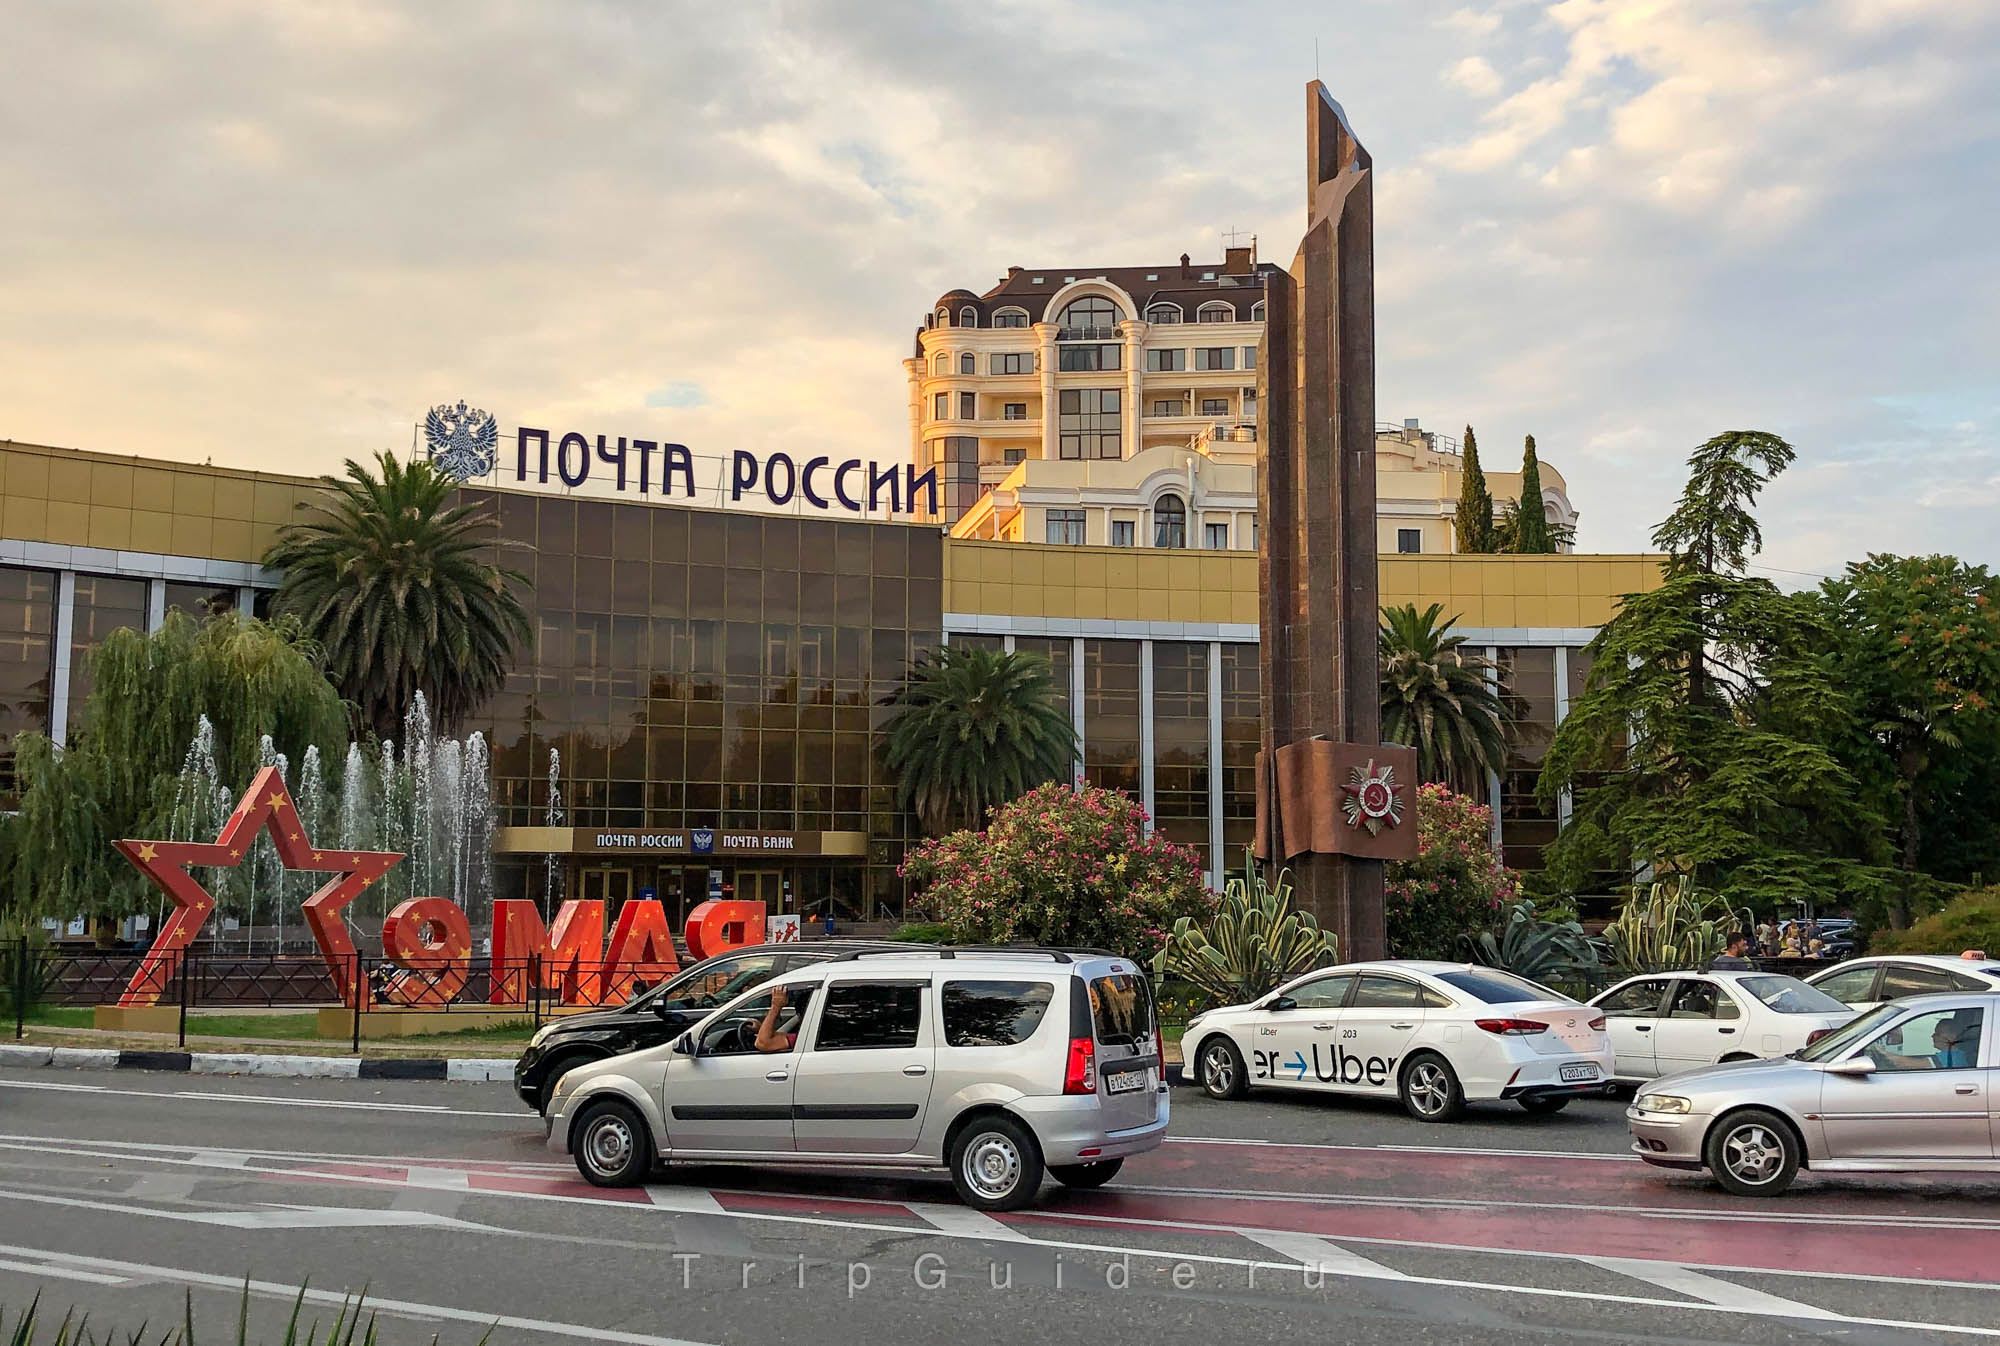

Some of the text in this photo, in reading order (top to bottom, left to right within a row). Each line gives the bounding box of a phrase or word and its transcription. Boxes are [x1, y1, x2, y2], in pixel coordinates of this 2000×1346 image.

[517, 427, 938, 515] ПОЧТА РОССИИ
[597, 834, 683, 848] ПОЧТА РОССИИ
[723, 835, 794, 849] ПОЧТА БАНК
[1260, 1028, 1278, 1036] Uber
[1342, 1030, 1357, 1039] 203
[1312, 1043, 1398, 1086] Uber
